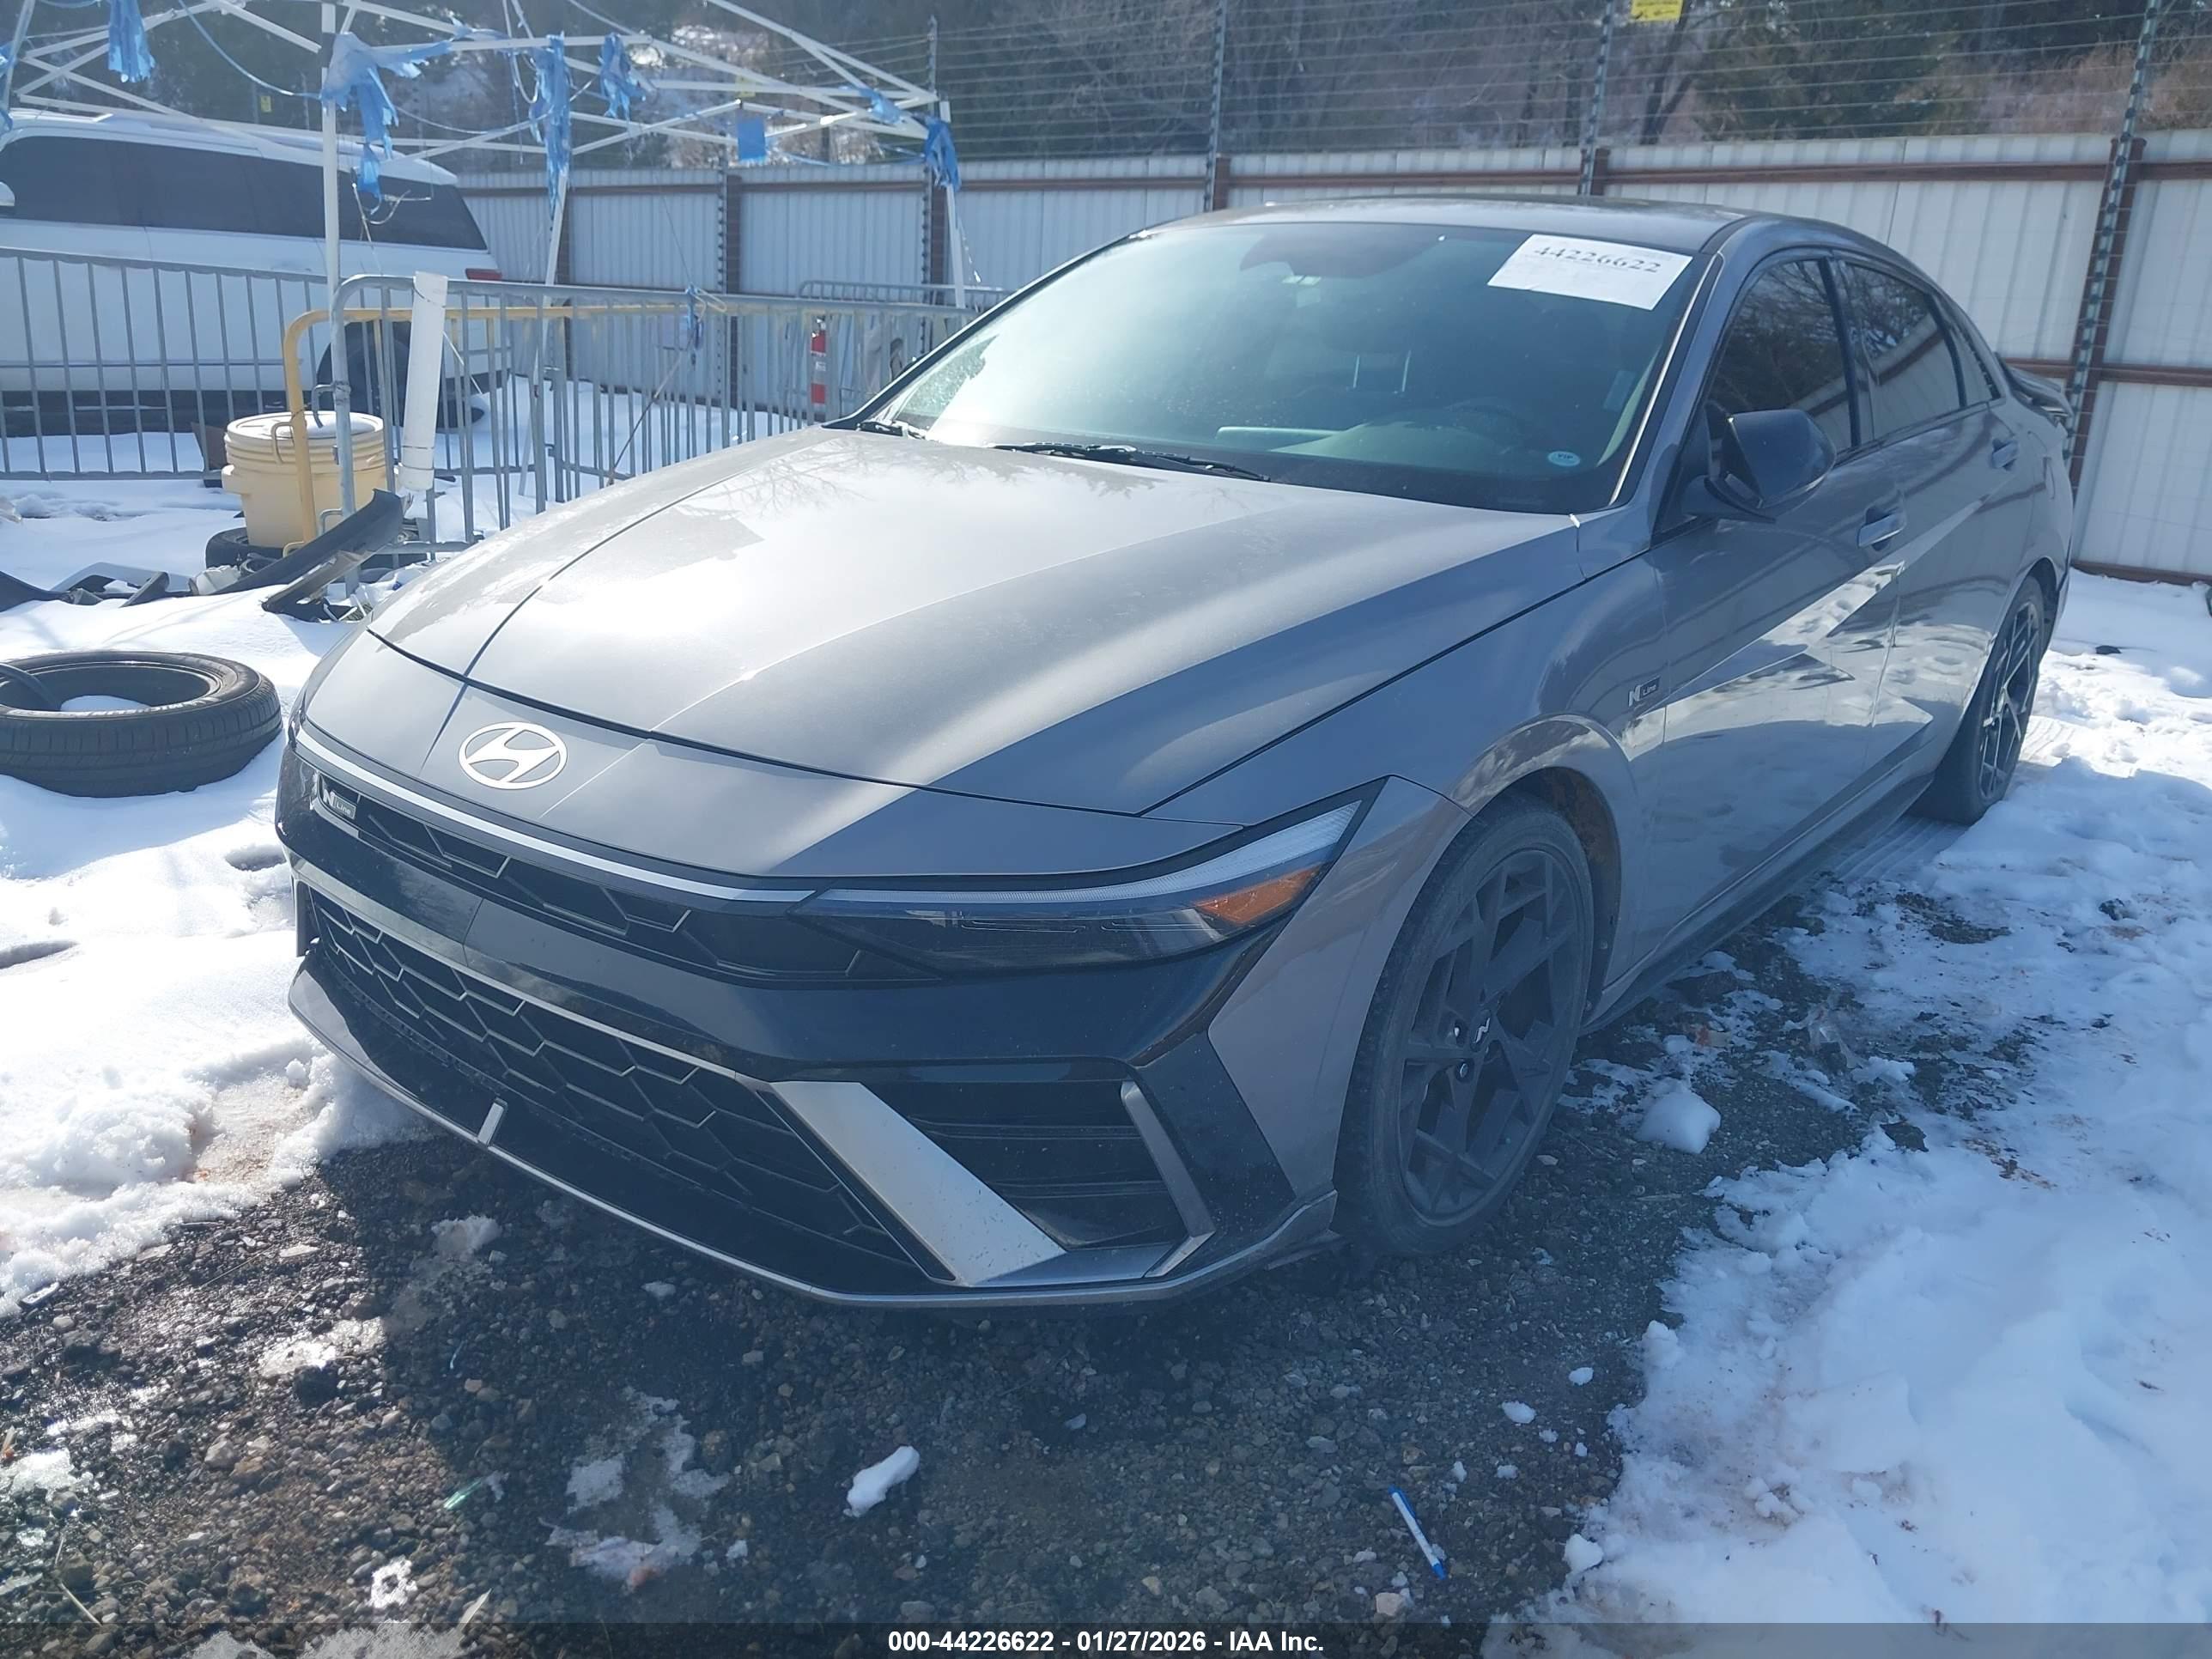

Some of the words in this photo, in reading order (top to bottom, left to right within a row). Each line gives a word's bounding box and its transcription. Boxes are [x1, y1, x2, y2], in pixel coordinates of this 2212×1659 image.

[1534, 246, 1662, 273] 44226622
[322, 788, 336, 808] N
[336, 801, 352, 815] Line
